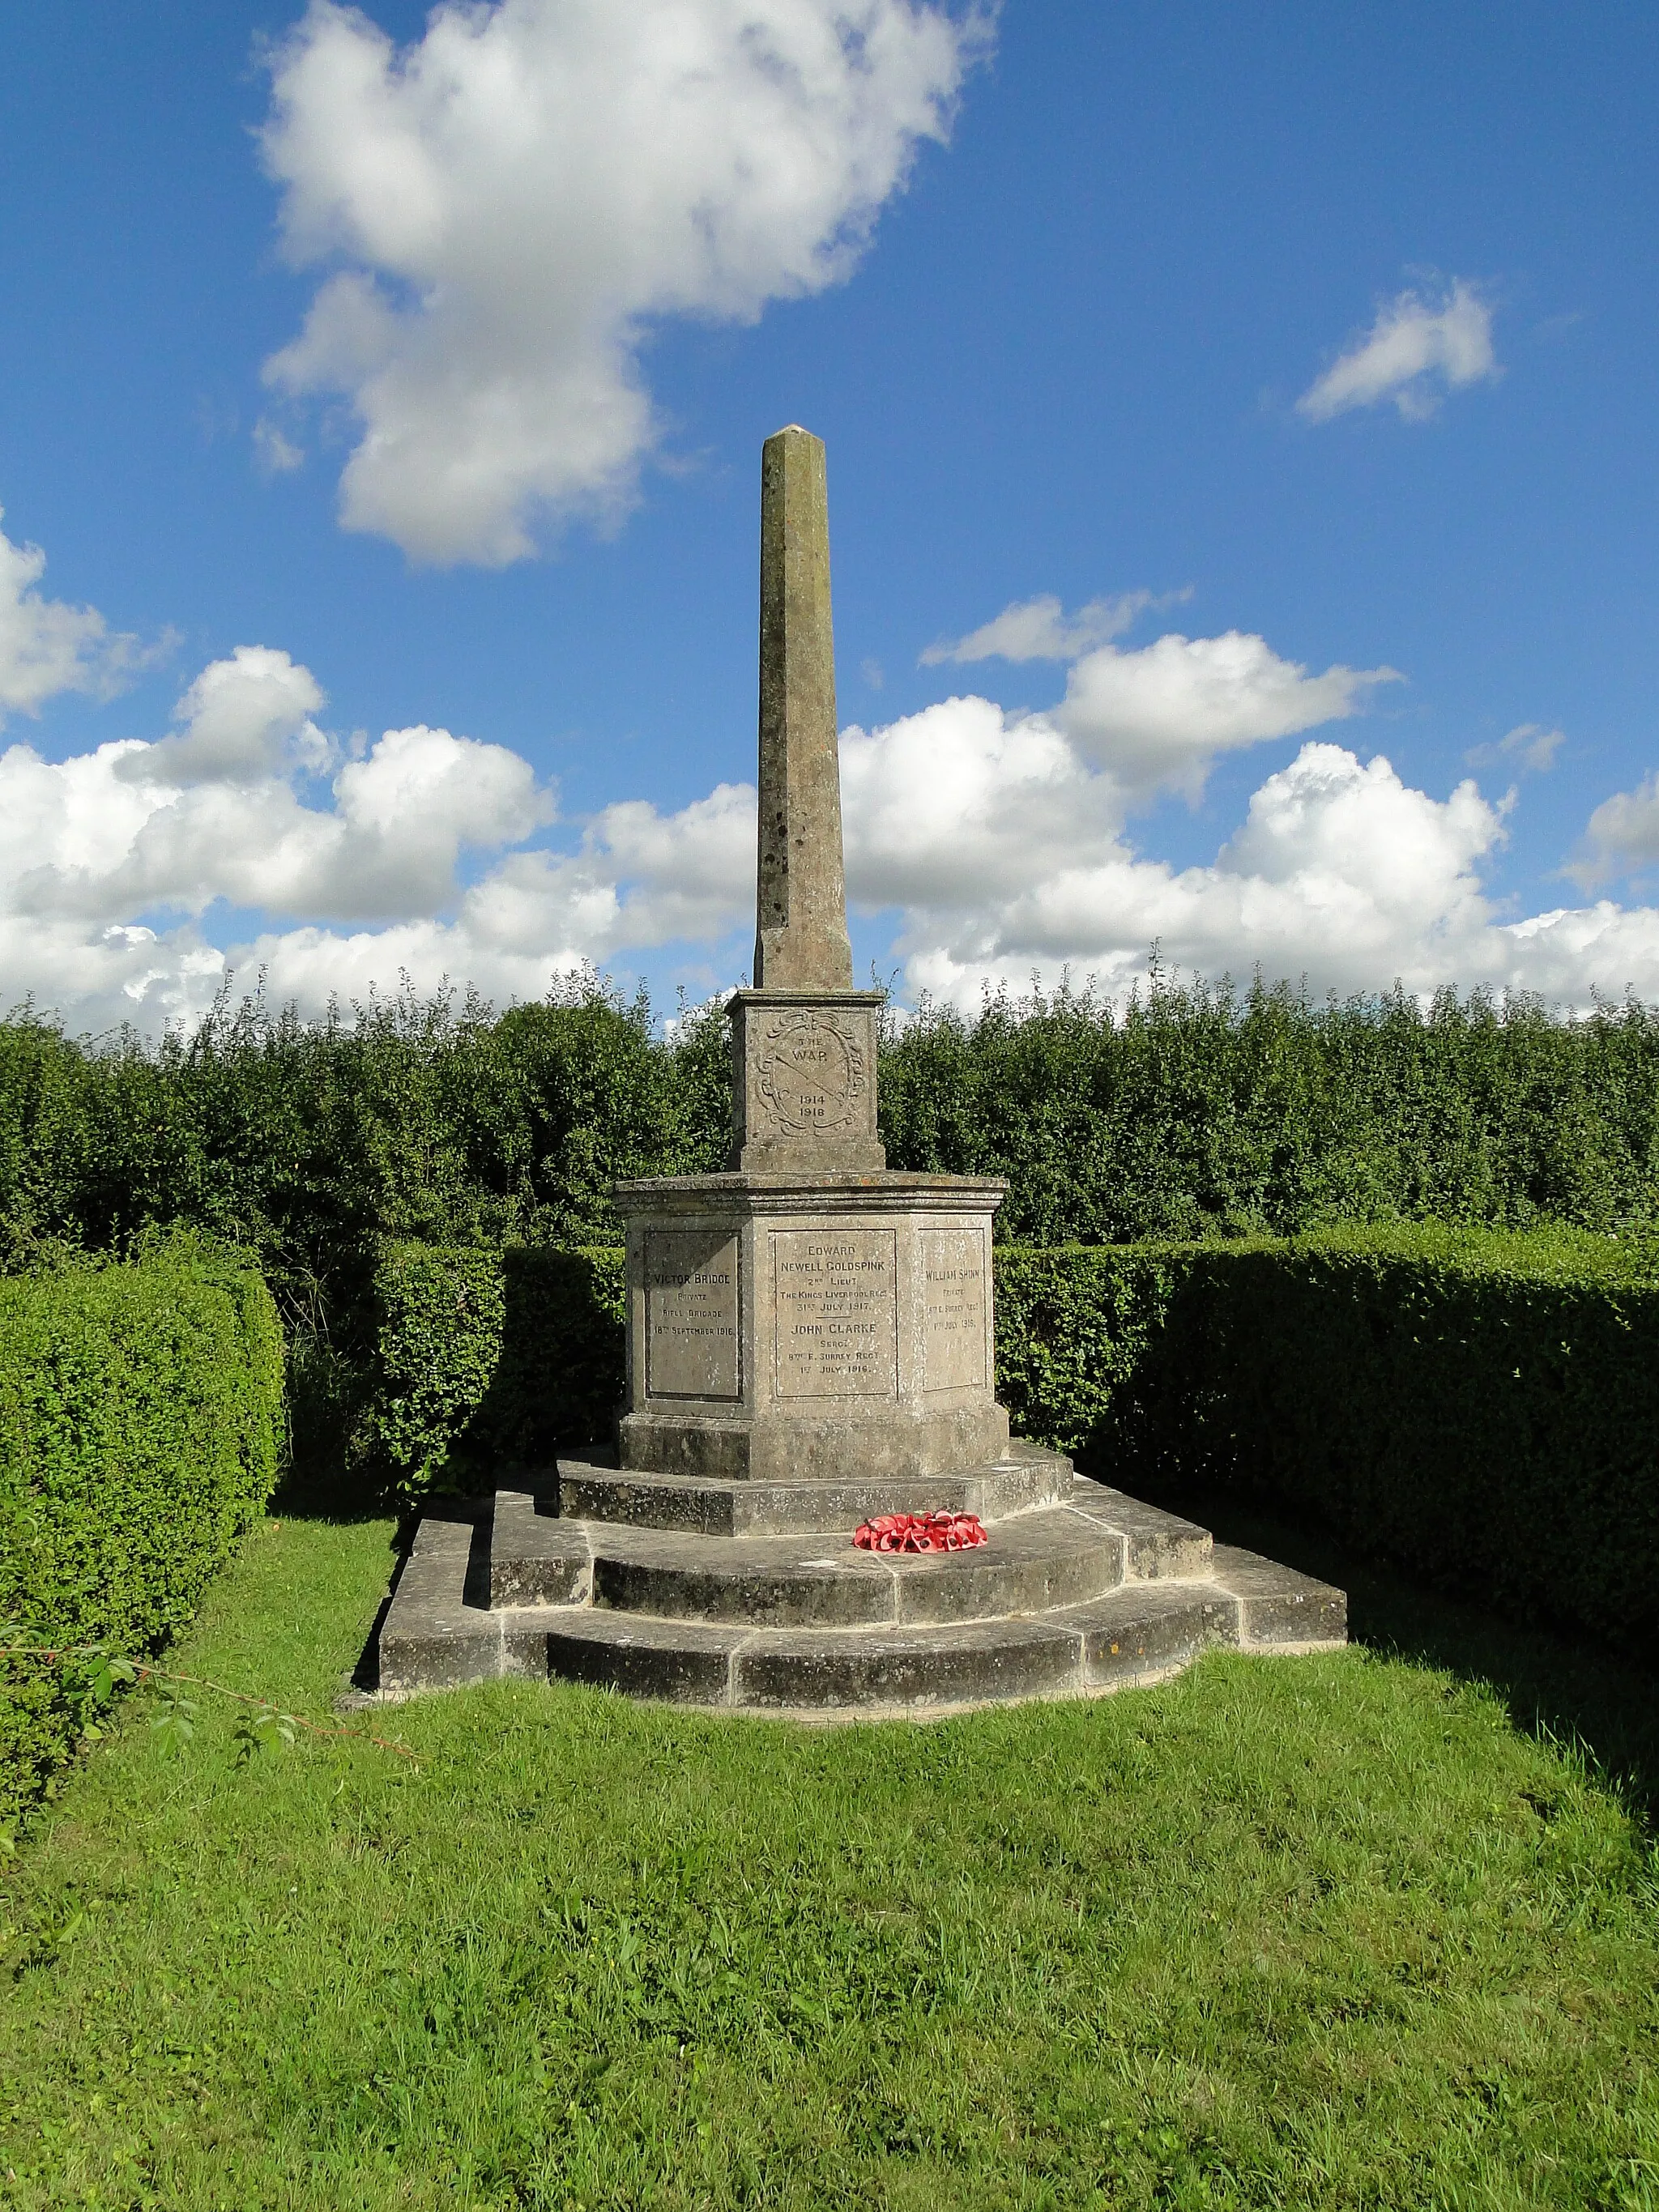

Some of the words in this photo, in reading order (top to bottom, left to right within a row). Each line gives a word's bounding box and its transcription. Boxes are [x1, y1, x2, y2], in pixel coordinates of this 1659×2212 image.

[798, 1038, 823, 1046] THE
[792, 1051, 827, 1061] WAR
[800, 1095, 825, 1105] 1914
[800, 1107, 825, 1116] 1918
[808, 1246, 855, 1255] EDWARD
[781, 1262, 823, 1272] NEWELL
[826, 1261, 885, 1271] GOLDSPINK
[655, 1274, 690, 1284] VICTOR
[694, 1273, 730, 1285] BRIDGE
[926, 1270, 956, 1281] WILLIAM
[959, 1268, 979, 1280] SHINN
[677, 1293, 706, 1301] PRIVATE
[781, 1291, 797, 1299] THE
[798, 1290, 823, 1299] KINGS
[825, 1290, 868, 1298] LIVERPOOL
[820, 1303, 844, 1311] JULY
[849, 1302, 872, 1311] 1917.
[663, 1309, 683, 1317] RIFLE
[689, 1309, 723, 1318] BRIGADE
[672, 1327, 714, 1335] SEPTEMBER
[791, 1325, 822, 1335] JOHN
[829, 1323, 876, 1334] CLARKE
[819, 1353, 851, 1361] SURREY
